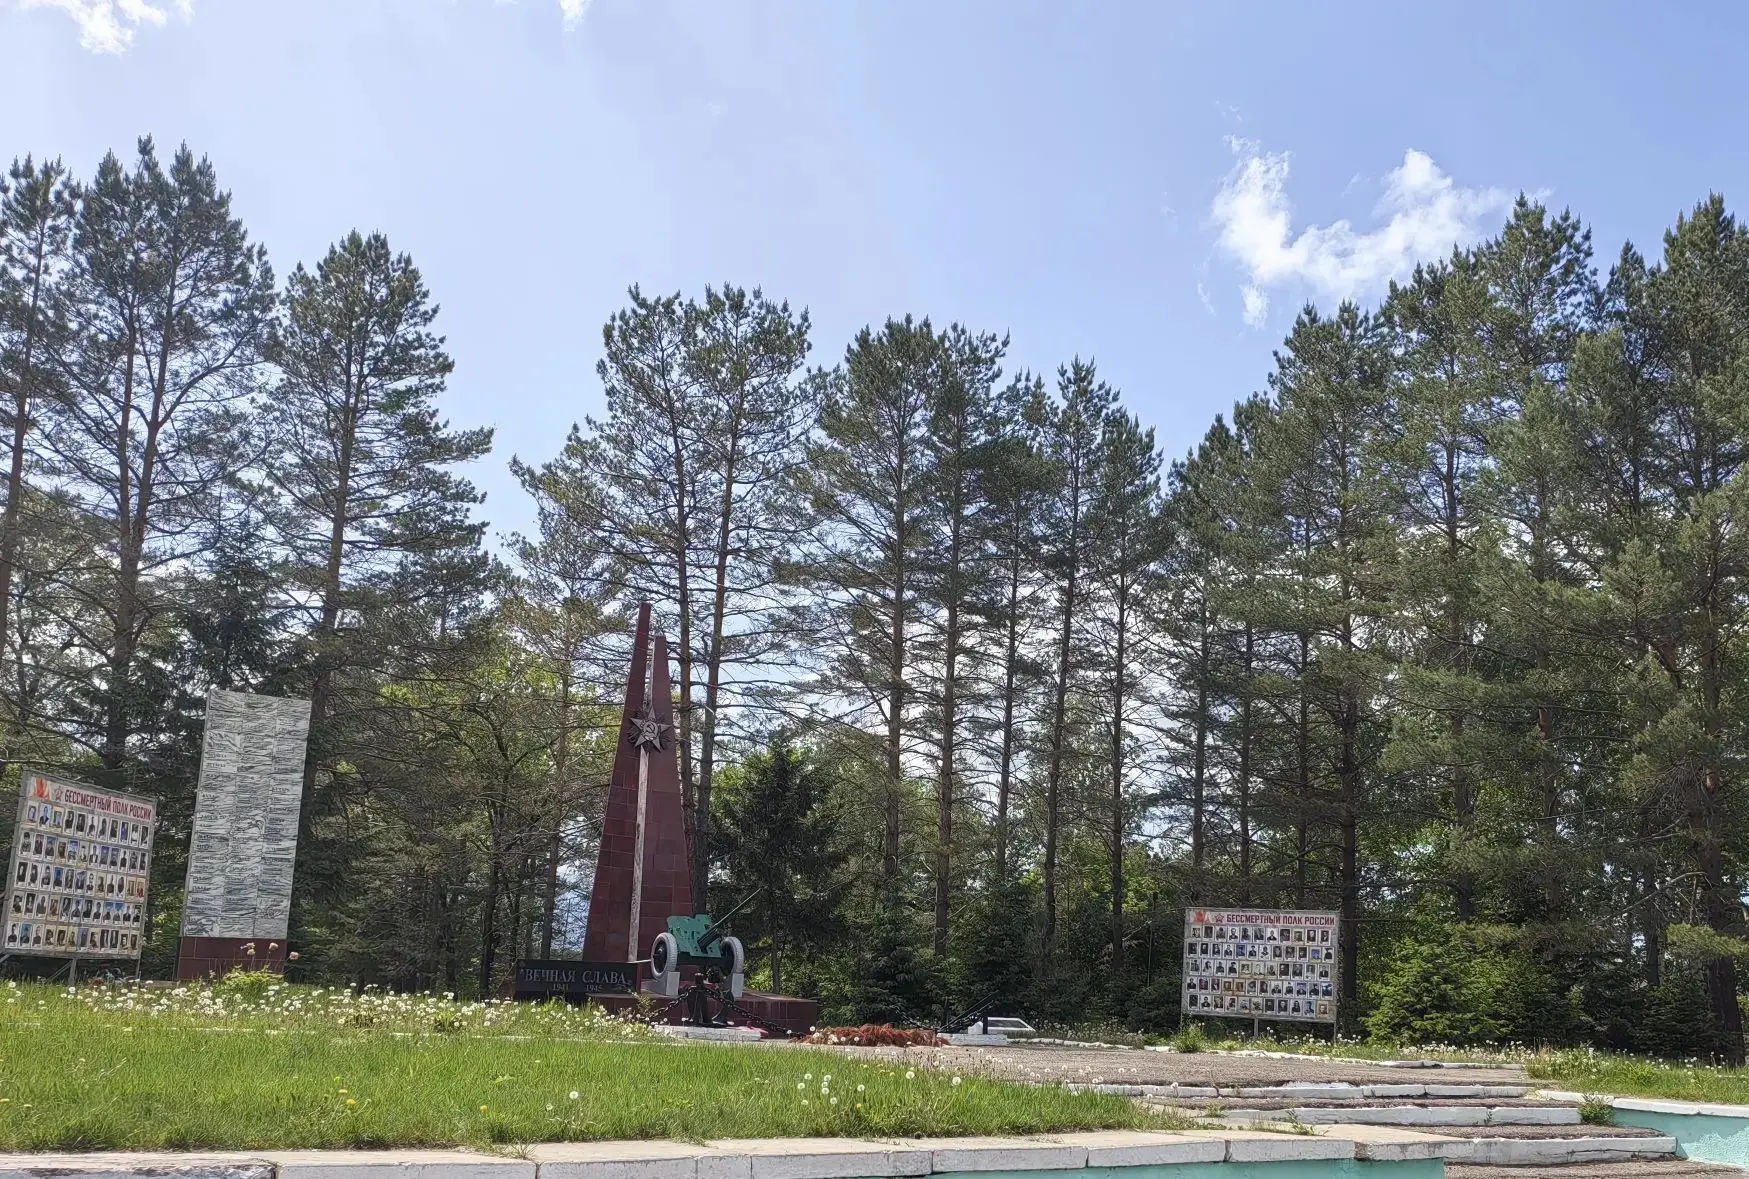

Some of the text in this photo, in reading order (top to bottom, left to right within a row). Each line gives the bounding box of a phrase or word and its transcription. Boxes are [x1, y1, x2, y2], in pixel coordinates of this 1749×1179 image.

[64, 789, 111, 811] БЕССМЕРТНЫЙ
[112, 800, 128, 815] ПОЛК
[1226, 913, 1335, 926] БЕССМЕРТНЫЙ ПОЛК РОССИИ
[525, 968, 627, 985] ВЕЧНАЯ СЛАВА
[585, 984, 603, 993] 1945
